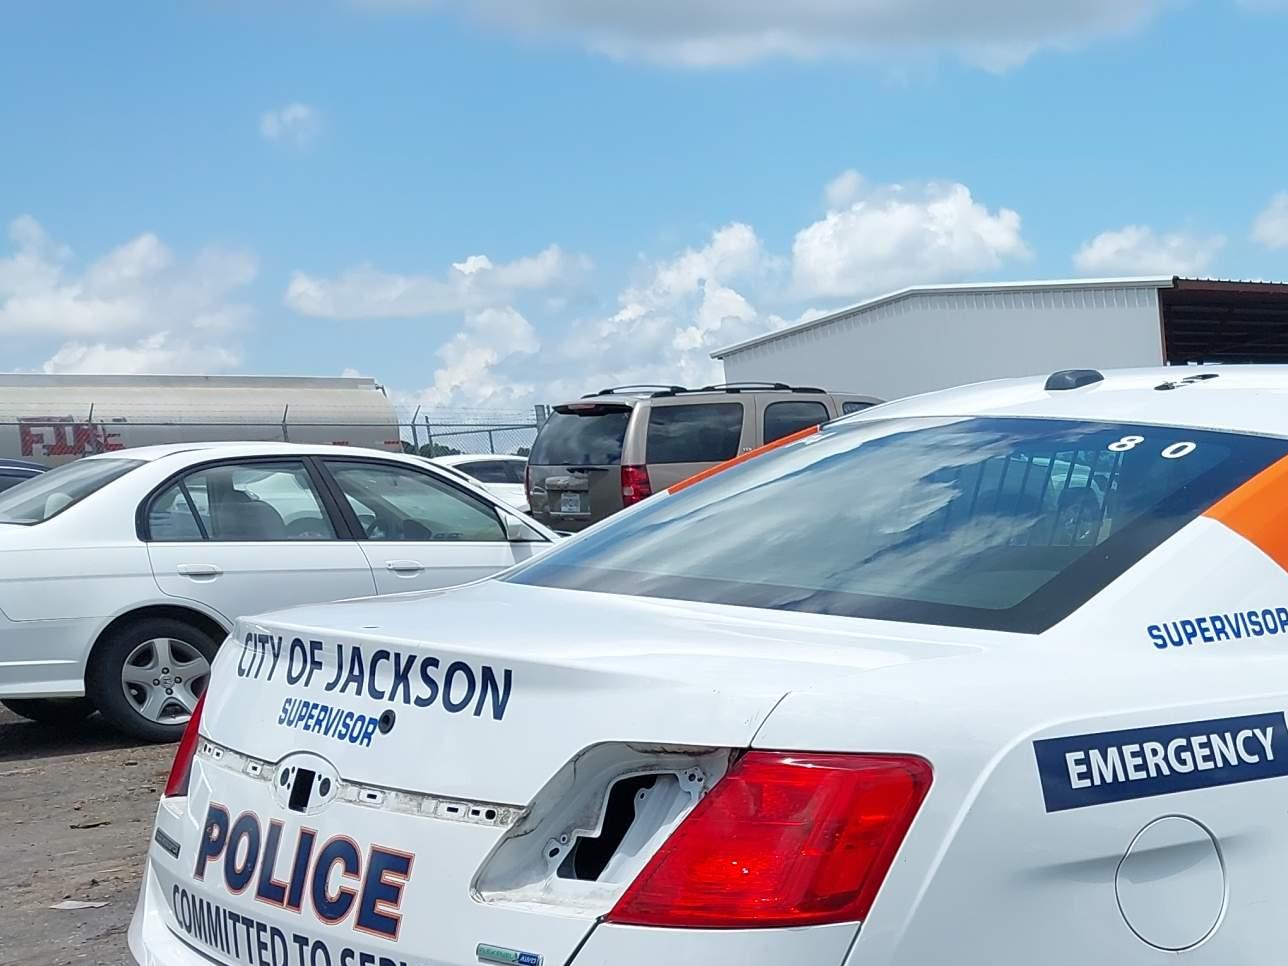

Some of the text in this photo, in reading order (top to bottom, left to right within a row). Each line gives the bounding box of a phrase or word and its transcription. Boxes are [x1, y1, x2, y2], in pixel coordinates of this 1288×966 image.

[1107, 435, 1197, 459] 8 0
[236, 632, 513, 721] CITY OF JACKSON
[278, 697, 378, 747] SUPERVISOR
[1064, 727, 1276, 790] EMERGENCY
[193, 801, 415, 941] POLICE
